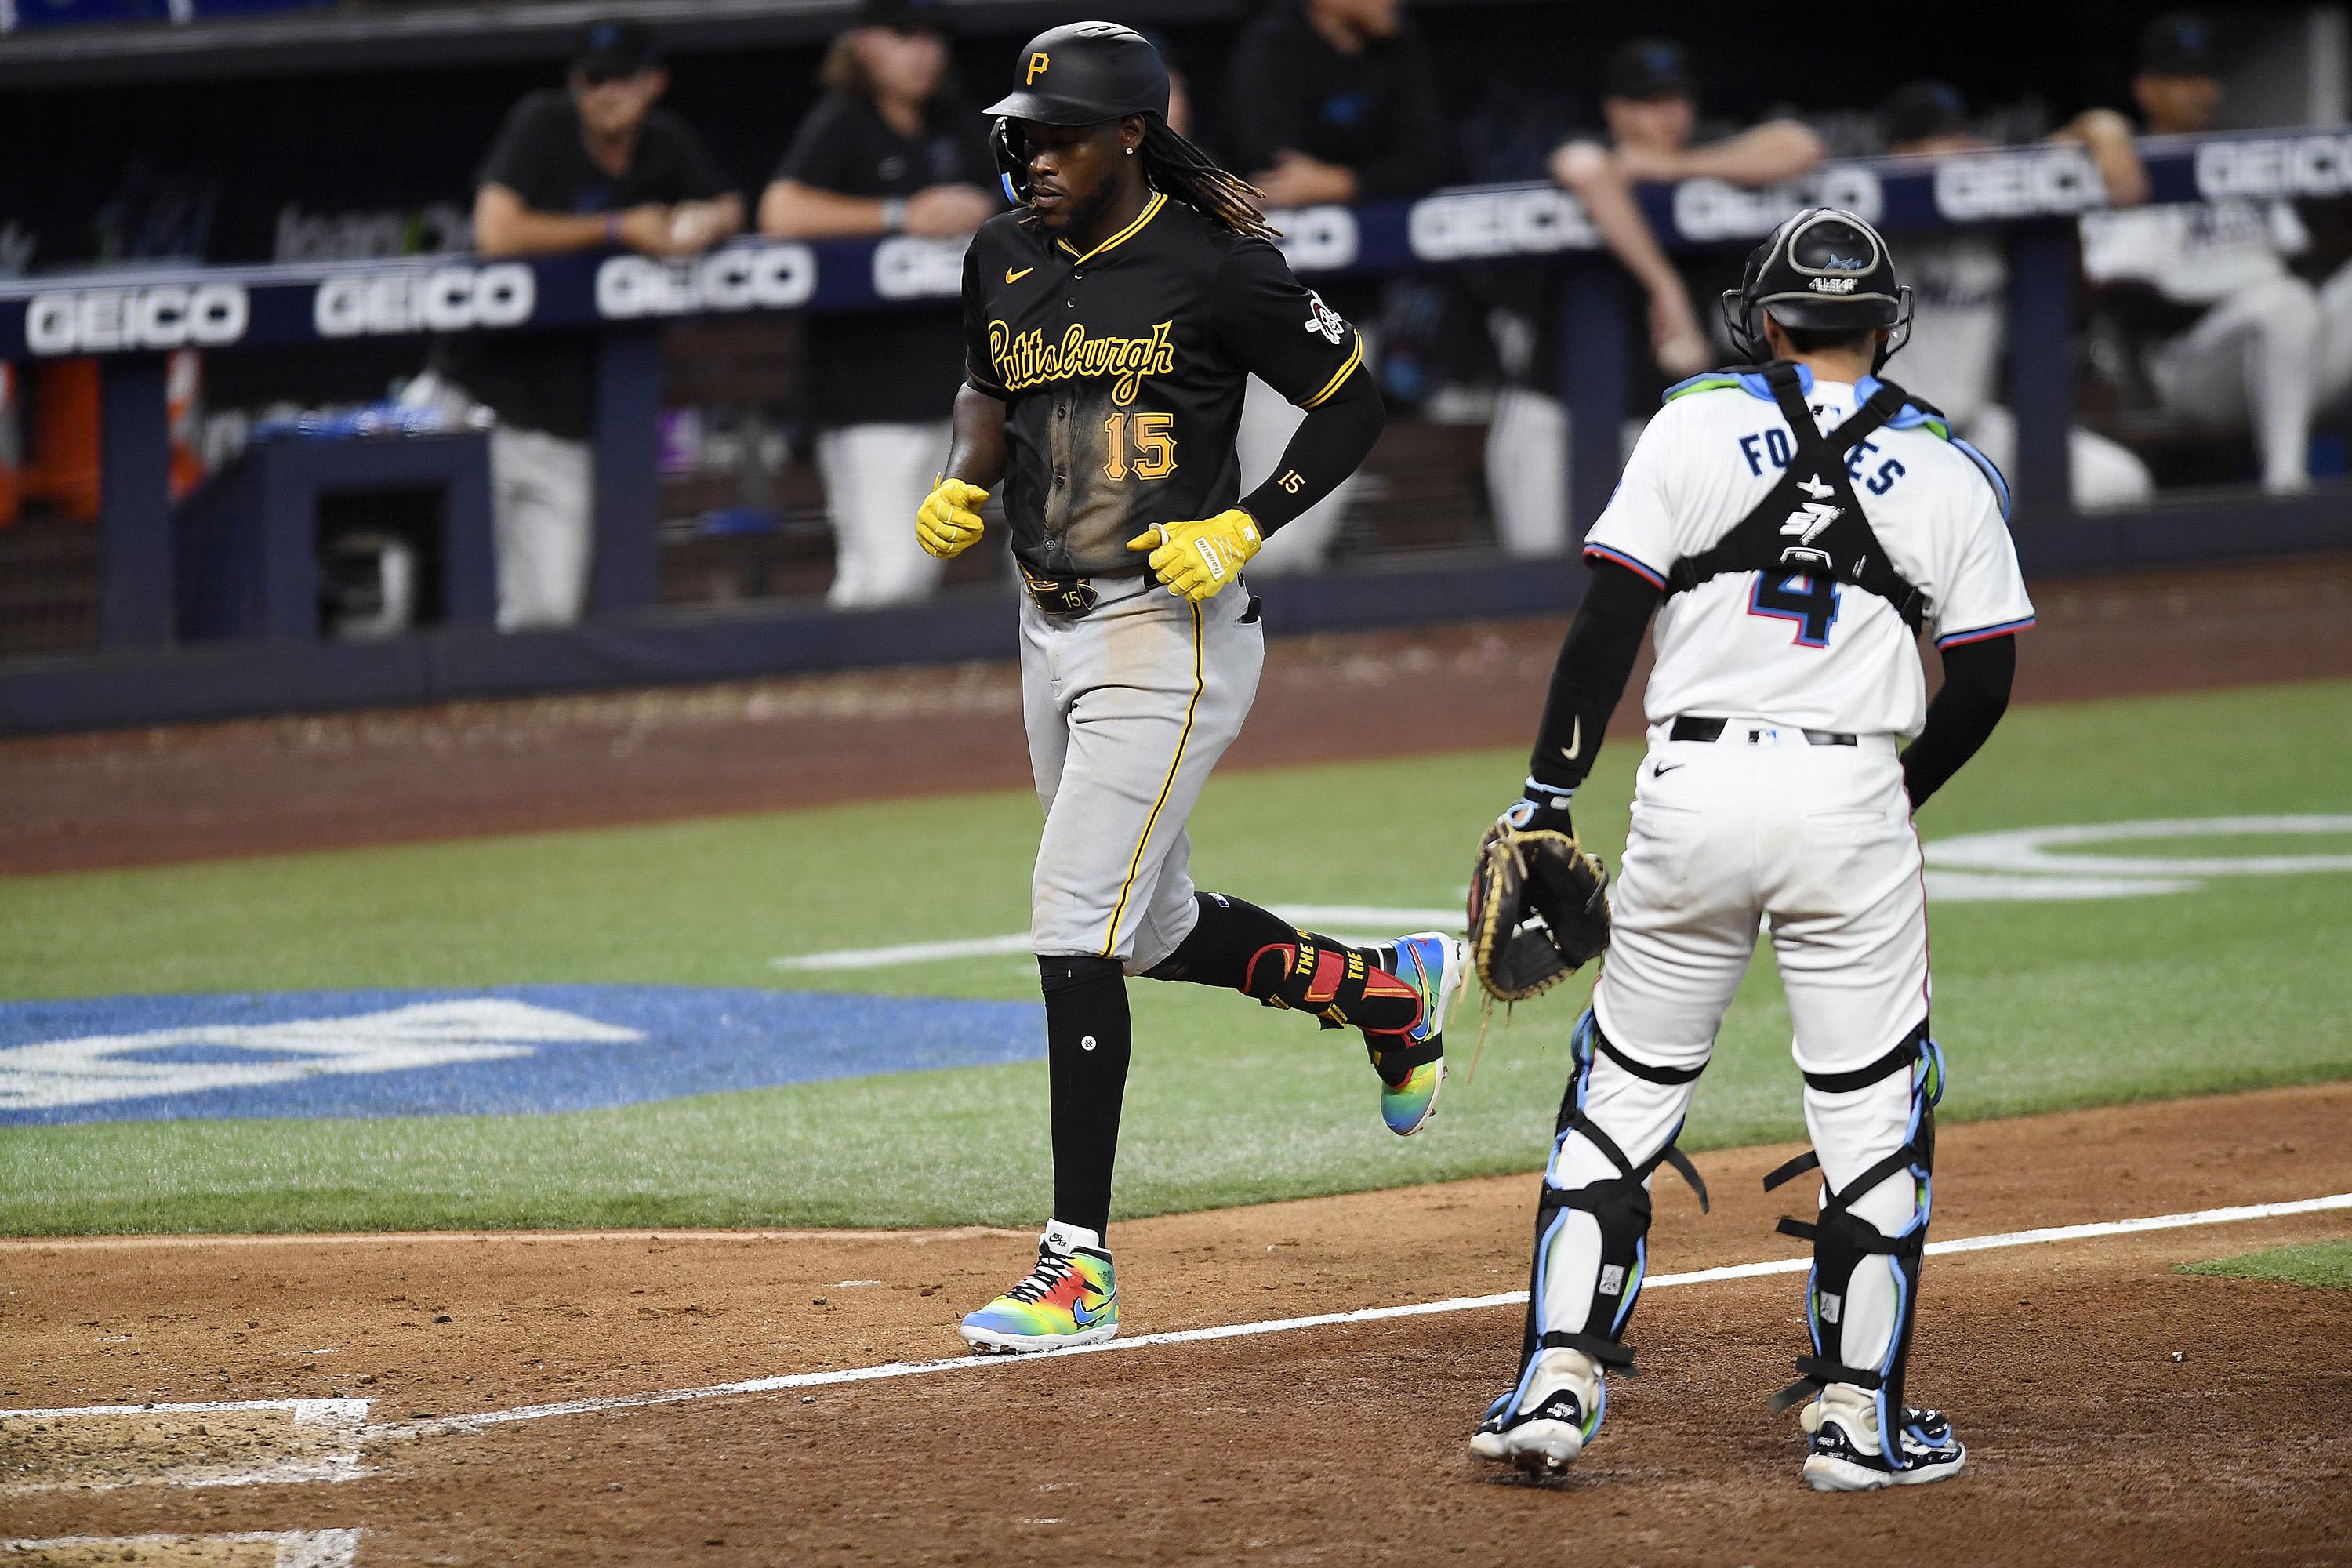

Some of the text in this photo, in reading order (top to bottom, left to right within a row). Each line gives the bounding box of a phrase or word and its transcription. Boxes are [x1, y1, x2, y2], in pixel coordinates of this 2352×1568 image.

[1025, 53, 1050, 85] P
[2195, 135, 2352, 200] GEIC
[24, 284, 249, 355] GEICO
[314, 263, 536, 338] GEICO
[989, 319, 1174, 406] Pittsburgh
[1103, 412, 1178, 481] 15
[1277, 470, 1306, 494] 15
[1062, 591, 1081, 608] 15
[1748, 570, 1842, 649] 4
[1295, 942, 1315, 975] THE
[1347, 950, 1365, 980] THE
